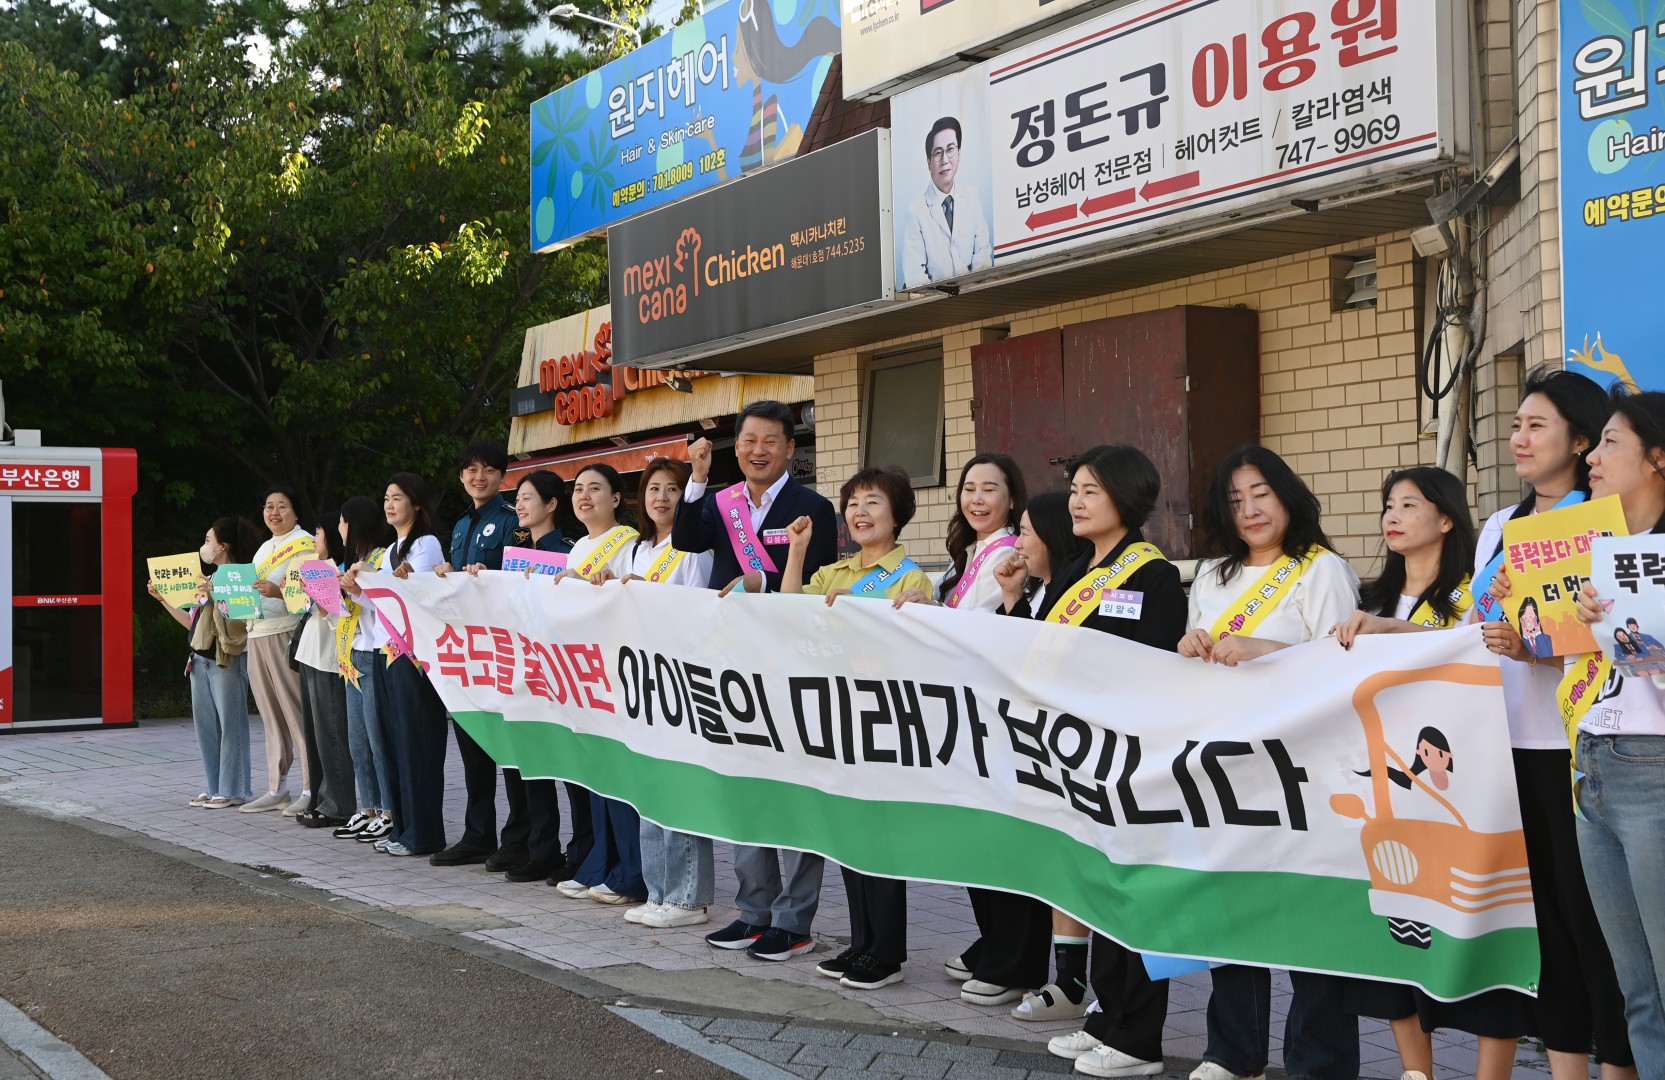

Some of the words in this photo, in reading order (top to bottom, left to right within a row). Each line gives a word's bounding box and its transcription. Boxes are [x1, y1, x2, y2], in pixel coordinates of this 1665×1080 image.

[608, 34, 729, 139] 원지헤어
[1010, 62, 1169, 168] 정돈규
[1191, 0, 1398, 108] 이용원
[1573, 22, 1665, 121] 원
[620, 148, 643, 166] Hair
[648, 142, 656, 154] &
[1015, 167, 1086, 209] 남성헤어
[1094, 148, 1152, 186] 전문점
[1174, 117, 1263, 161] 헤어컷트
[1291, 76, 1392, 130] 칼라염색
[1608, 126, 1665, 161] Hair
[611, 181, 645, 208] 예약문의
[652, 167, 693, 193] 701.8009
[699, 149, 726, 175] 102호
[790, 217, 847, 247] 멕시카나치킨
[704, 241, 785, 287] Chicken
[791, 249, 825, 270] 해운대1호점
[826, 236, 865, 260] 744.5235
[623, 255, 670, 296] mexi
[639, 284, 687, 324] cana
[539, 349, 597, 393] mexi
[555, 383, 613, 425] cana
[0, 468, 80, 488] 부산은행
[729, 508, 748, 543] 폭력은
[766, 536, 788, 544] 김성수
[503, 558, 531, 571] 교폭력
[659, 548, 679, 573] 력은
[1093, 552, 1139, 590] 폭력은
[1508, 540, 1572, 573] 폭력보다
[1111, 592, 1134, 600] 시의원
[1542, 583, 1561, 602] 더
[1562, 575, 1591, 603] 멋
[1104, 603, 1136, 616] 임말숙
[435, 623, 516, 695] 속도를
[517, 631, 616, 714] 줄이면
[617, 645, 784, 753] 아이들의
[788, 676, 989, 779] 미래가
[998, 697, 1309, 832] 보입니다
